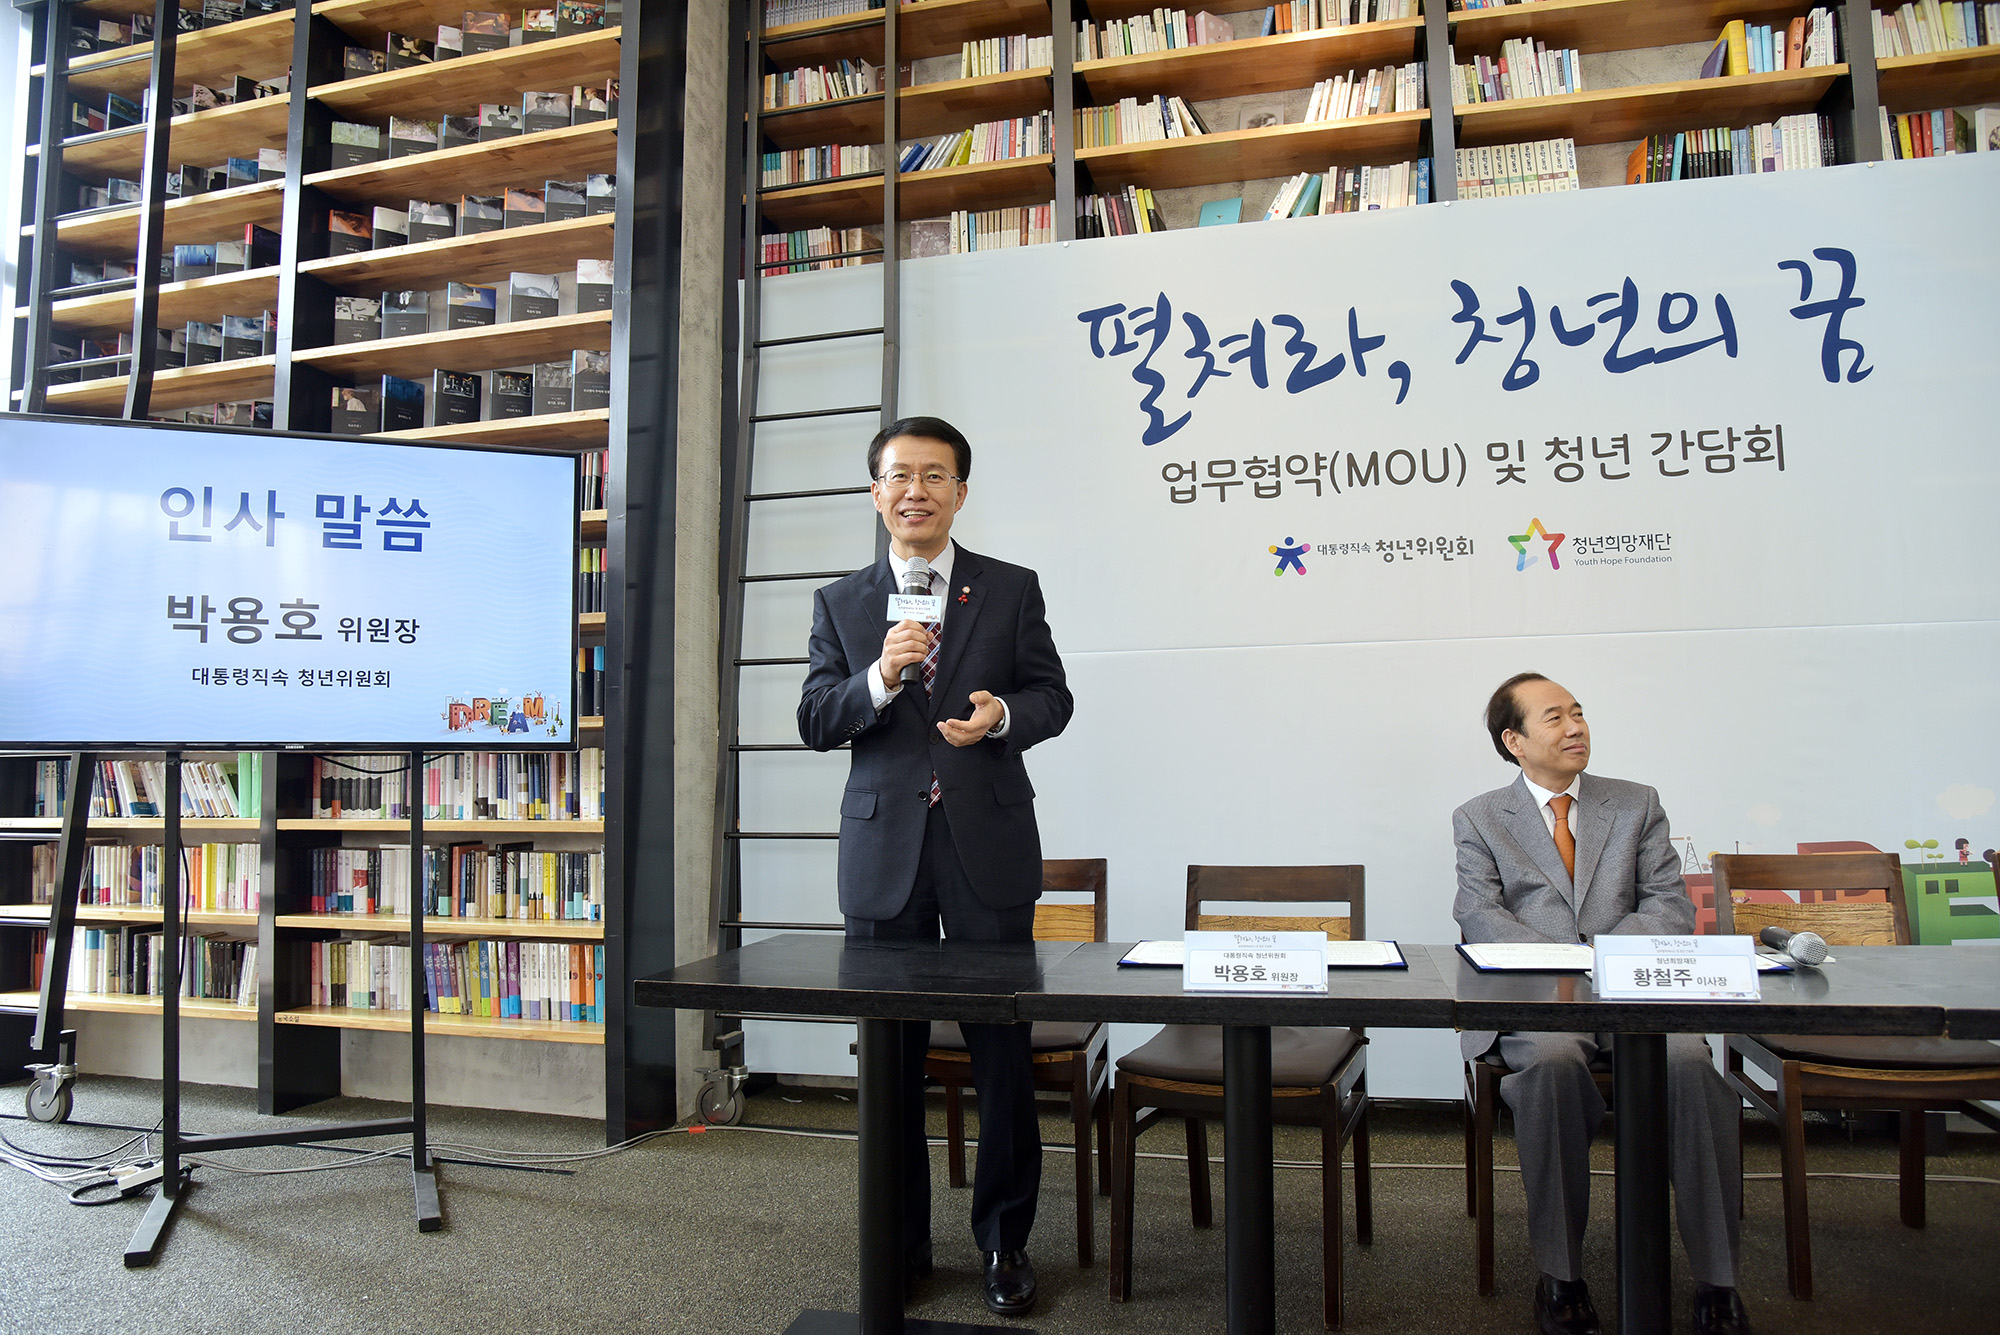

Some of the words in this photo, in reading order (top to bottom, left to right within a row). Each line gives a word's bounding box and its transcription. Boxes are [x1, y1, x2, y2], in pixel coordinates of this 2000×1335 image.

[1076, 291, 1412, 446] 펼쳐라,
[1450, 275, 1739, 392] 청년의
[1777, 247, 1875, 384] 꿈
[1161, 443, 1468, 505] 업무협약(MOU)
[1486, 439, 1527, 486] 및
[1544, 433, 1631, 483] 청년
[1650, 423, 1786, 477] 간담회
[160, 485, 286, 548] 인사
[315, 494, 431, 553] 말씀
[1317, 541, 1372, 556] 대통령직속
[1375, 535, 1474, 564] 청년위원회
[1572, 532, 1672, 555] 청년희망재단
[1573, 557, 1599, 567] Youth
[1599, 557, 1623, 567] Hope
[1624, 555, 1673, 565] Foundation
[167, 594, 323, 645] 박용호
[337, 616, 421, 645] 위원장
[191, 667, 289, 687] 대통령직속
[298, 668, 391, 689] 청년위원회
[448, 697, 544, 733] DREAM
[1223, 952, 1254, 960] 대통령직속
[1255, 952, 1287, 960] 청년위원회
[1214, 964, 1268, 983] 박용호
[1271, 972, 1299, 983] 위원장
[1633, 968, 1693, 987] 황철주
[1697, 976, 1728, 987] 이사장
